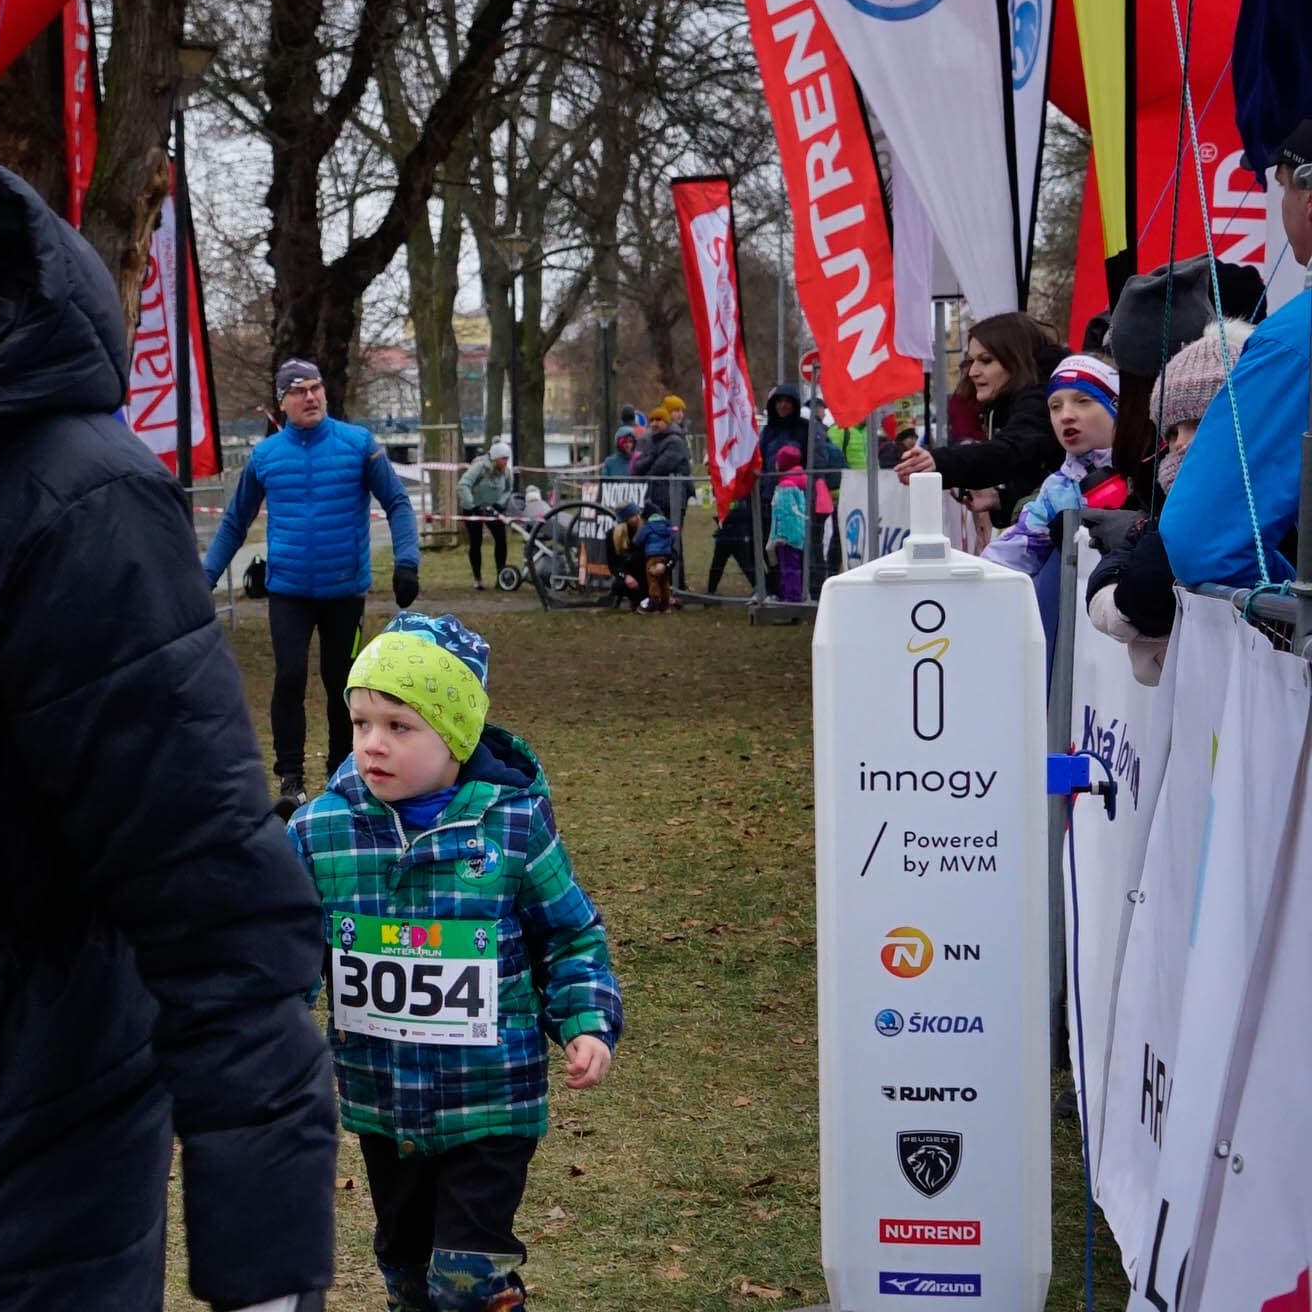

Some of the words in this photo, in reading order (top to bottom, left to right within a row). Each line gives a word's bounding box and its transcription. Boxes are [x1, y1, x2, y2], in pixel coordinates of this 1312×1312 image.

[860, 761, 998, 799] innogy
[903, 830, 998, 848] Powered
[903, 854, 930, 878] by
[940, 855, 997, 873] MVM
[943, 944, 981, 961] NN
[339, 955, 485, 1018] 3054
[908, 1012, 985, 1034] ŠKODA
[899, 1086, 978, 1102] RUNTO
[902, 1135, 957, 1144] PEUGEOT
[885, 1224, 977, 1240] NUTREND
